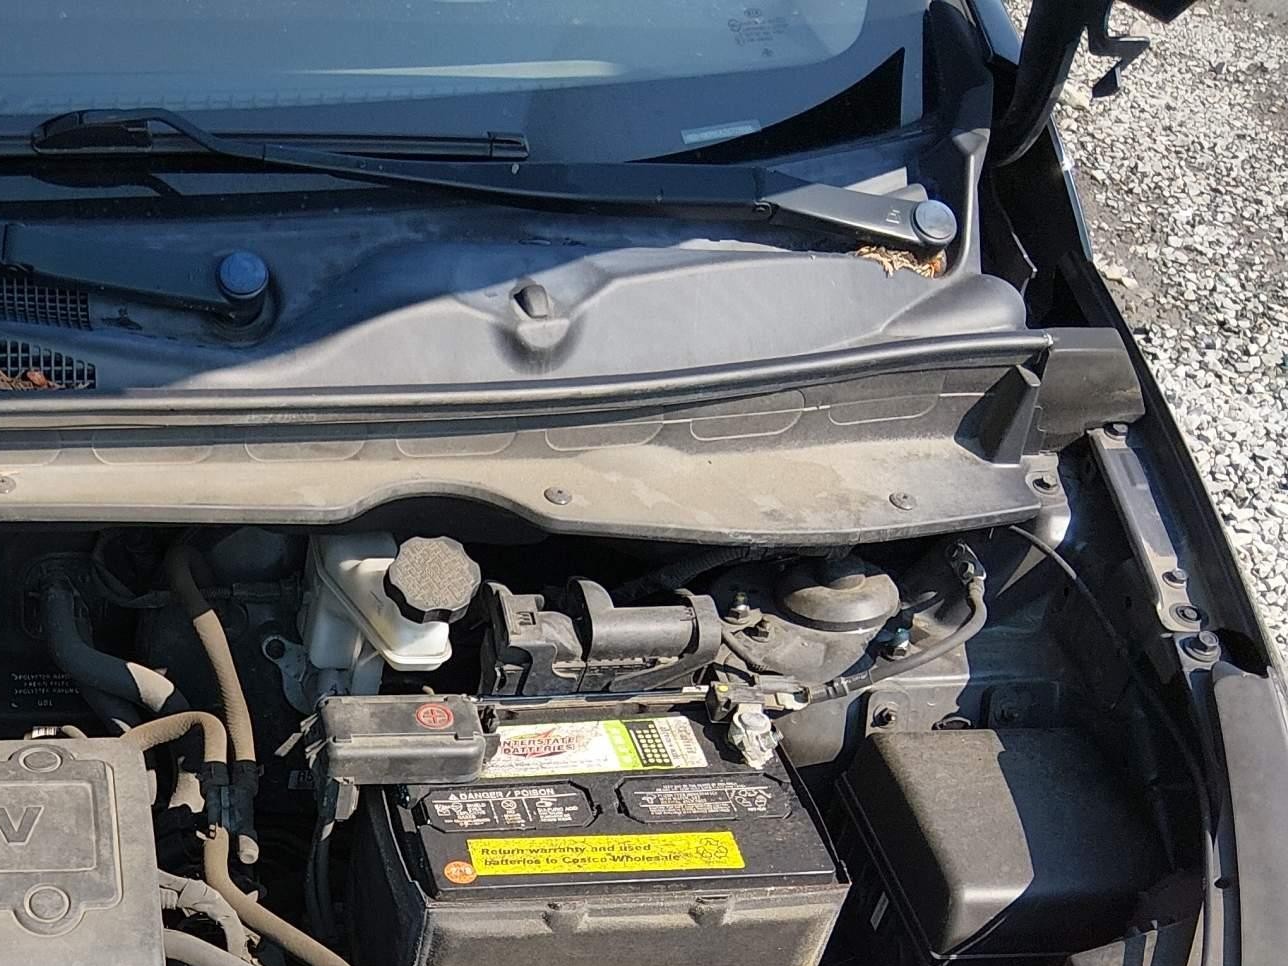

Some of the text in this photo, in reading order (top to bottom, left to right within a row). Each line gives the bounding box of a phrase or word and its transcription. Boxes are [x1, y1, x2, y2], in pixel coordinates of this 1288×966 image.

[502, 735, 575, 746] NTERSTATE
[459, 790, 503, 800] DANGER
[514, 788, 555, 797] POISON
[481, 843, 651, 856] Return warranty and used
[484, 857, 541, 866] batteries
[562, 856, 607, 864] Costco
[611, 853, 681, 863] Wholesale
